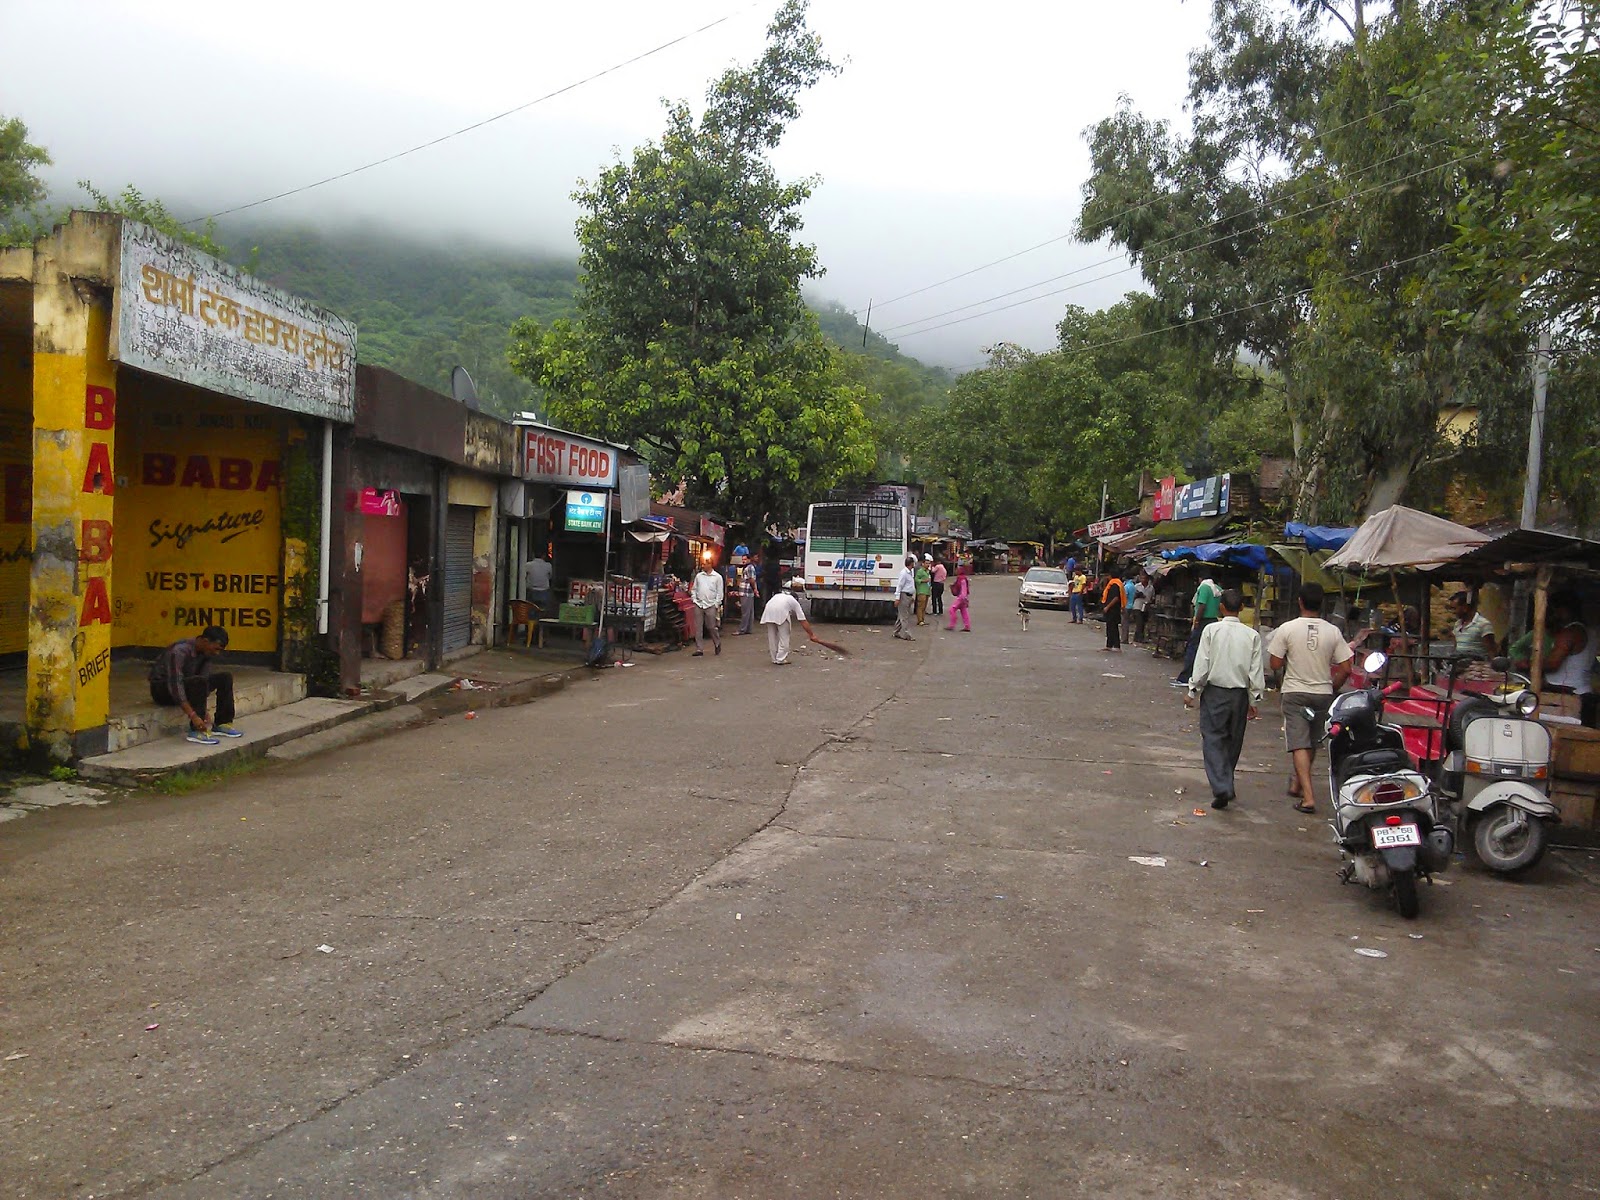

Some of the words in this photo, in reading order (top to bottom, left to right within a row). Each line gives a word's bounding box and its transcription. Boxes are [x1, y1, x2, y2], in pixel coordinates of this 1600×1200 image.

[526, 432, 566, 475] FAST
[569, 444, 610, 478] FOOD
[142, 453, 281, 492] BABA
[80, 384, 116, 626] BABA
[149, 509, 264, 549] Signature
[568, 519, 581, 527] STATE
[593, 521, 602, 529] ATM
[834, 559, 876, 570] ATLAS
[146, 572, 204, 591] VEST
[213, 574, 278, 594] BRIEF
[174, 607, 272, 628] PANTIES
[1306, 626, 1319, 651] 5
[79, 648, 109, 687] BRIEF
[1380, 835, 1412, 844] 1961
